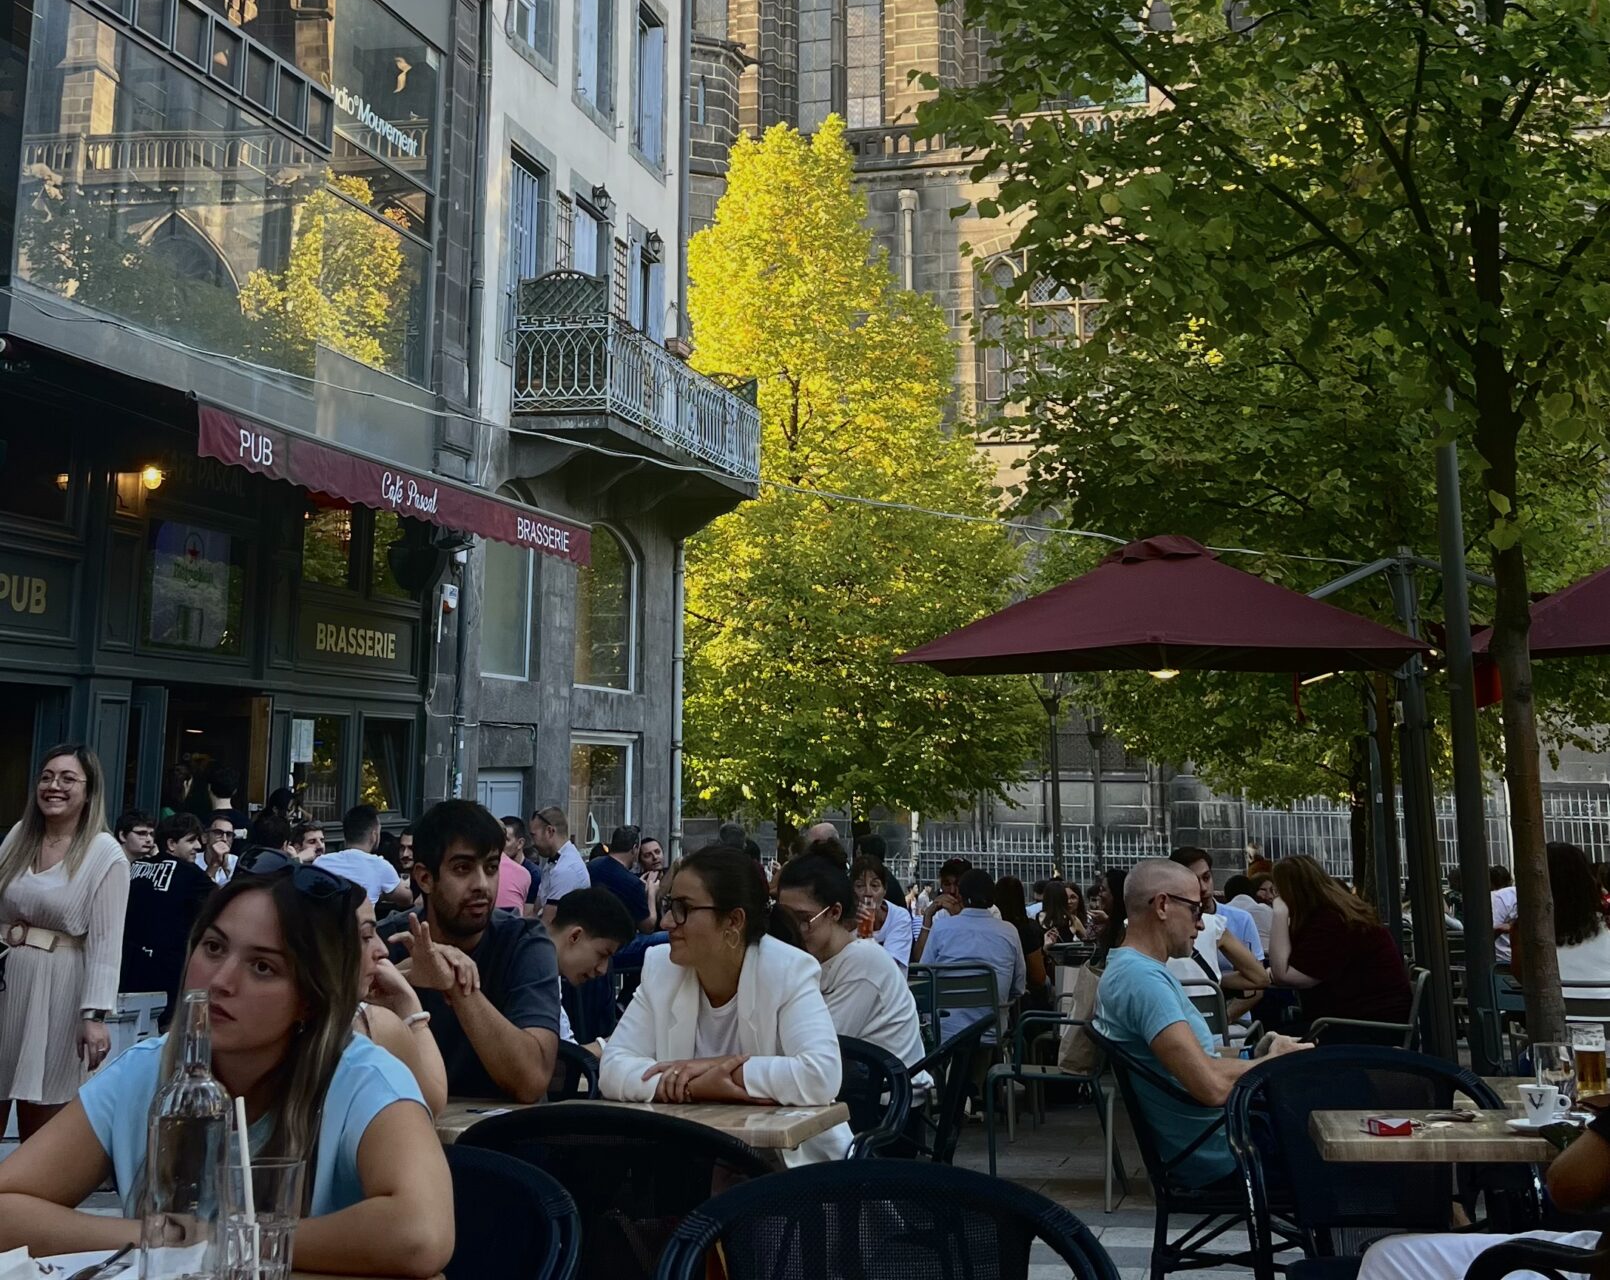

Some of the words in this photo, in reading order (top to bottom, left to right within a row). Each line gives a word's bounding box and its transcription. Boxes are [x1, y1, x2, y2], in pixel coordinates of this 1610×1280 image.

[357, 98, 418, 158] Mouvement
[240, 428, 273, 466] PUB
[381, 471, 404, 508] Café
[407, 480, 438, 514] Pascal
[517, 516, 570, 553] BRASSERIE
[0, 572, 47, 614] PUB
[315, 622, 396, 659] BRASSERIE
